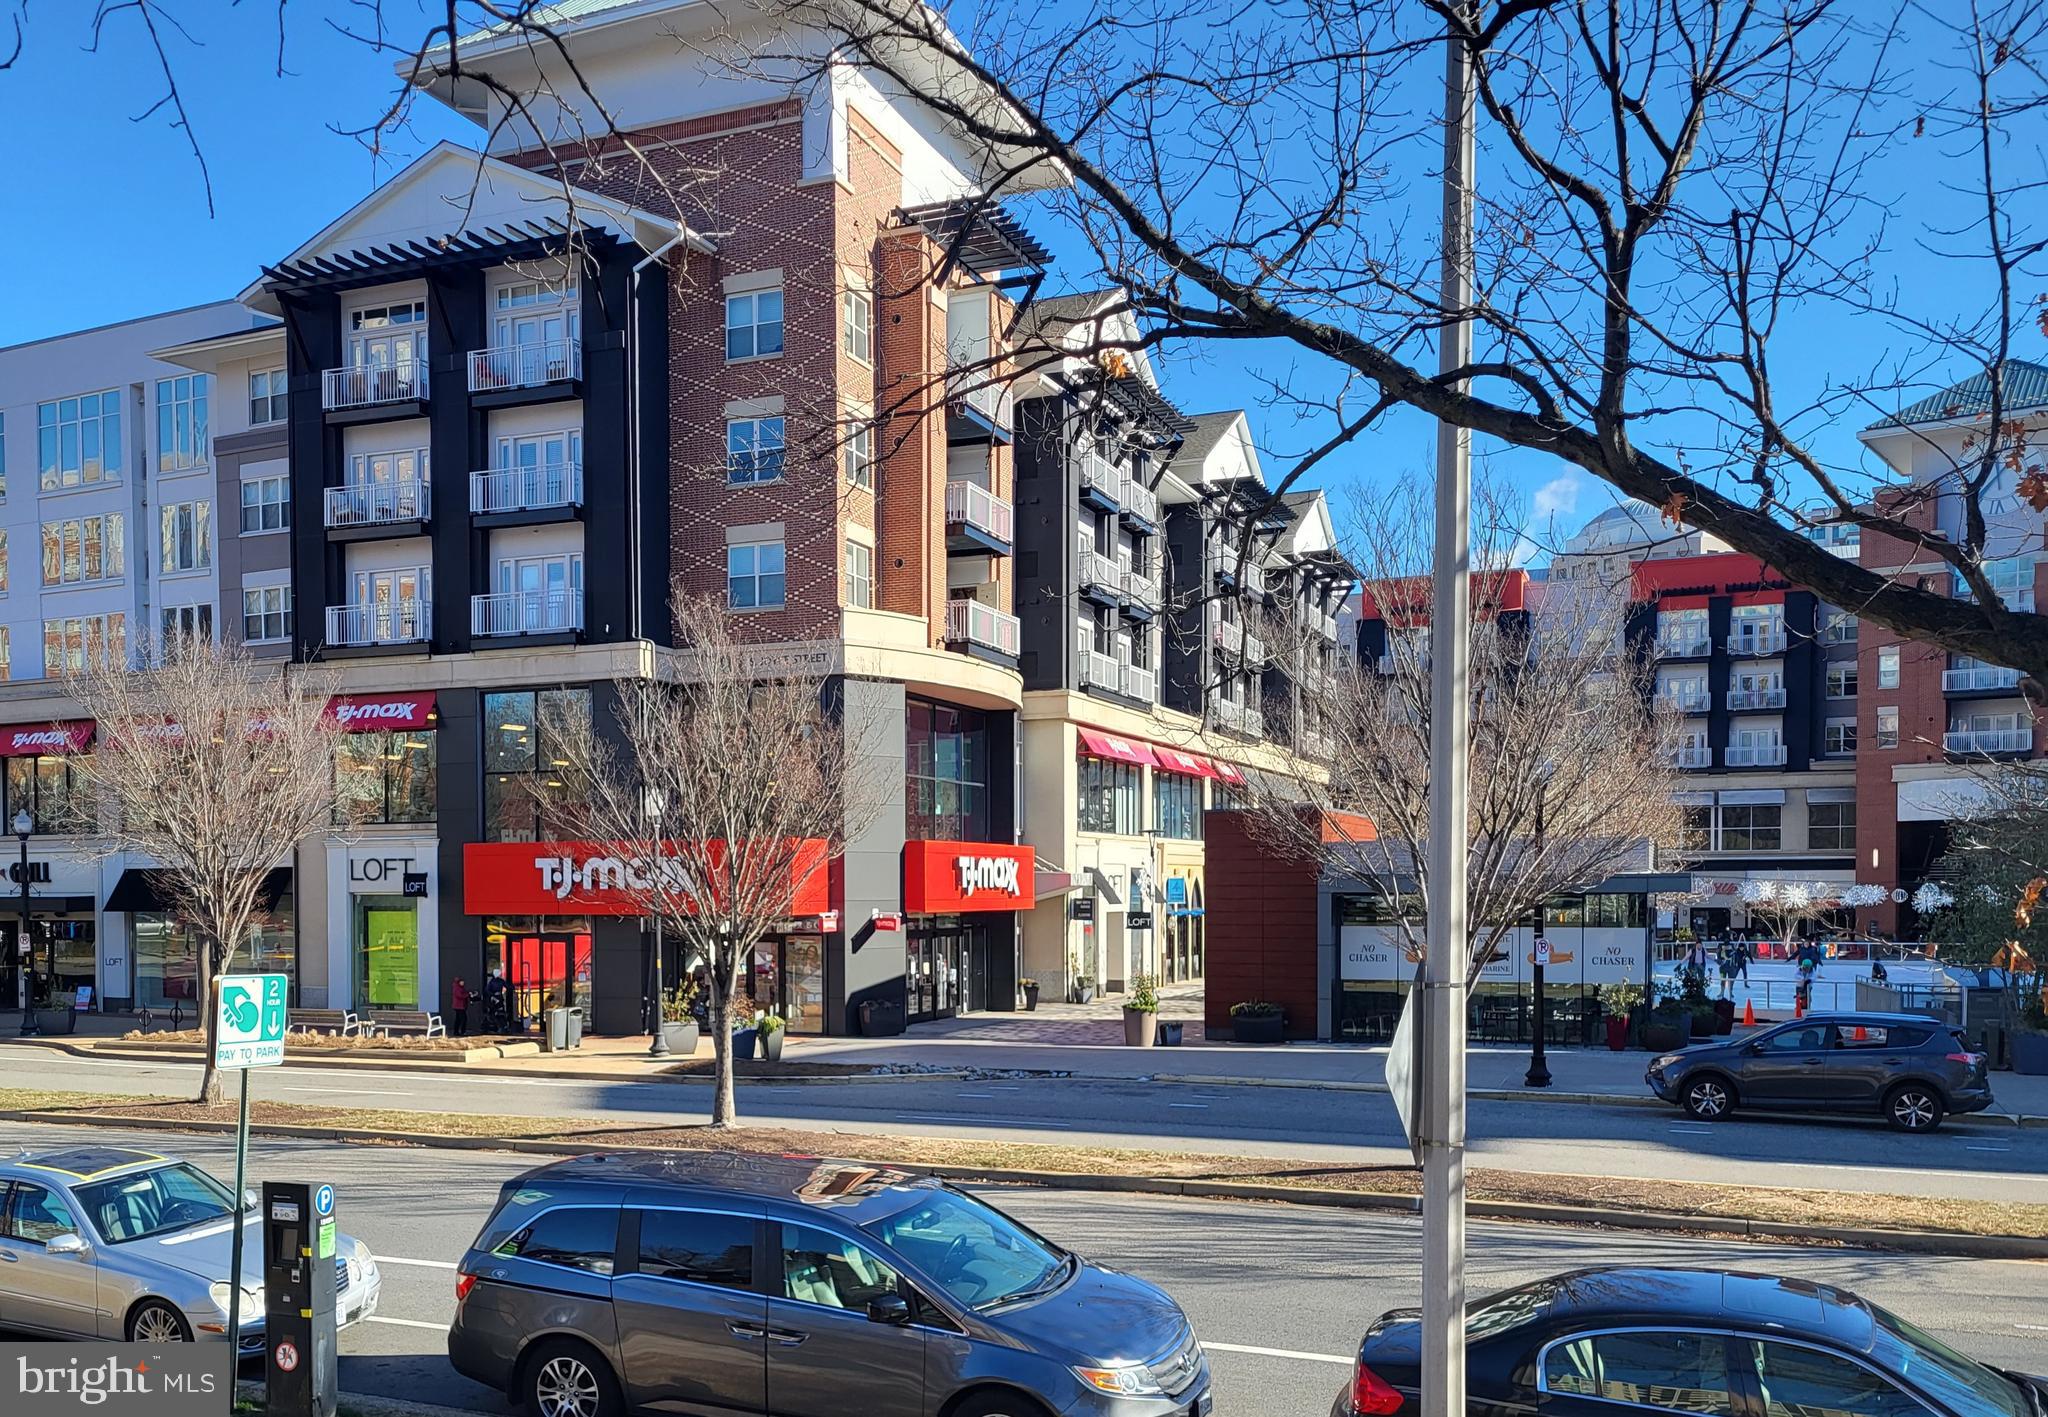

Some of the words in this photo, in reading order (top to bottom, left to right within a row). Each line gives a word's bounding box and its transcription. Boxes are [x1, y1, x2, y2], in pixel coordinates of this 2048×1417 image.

[9, 862, 52, 883] GILL
[350, 857, 415, 881] LOFT
[405, 882, 425, 892] LOFT
[1127, 917, 1151, 927] LOFT
[1361, 944, 1376, 953] NO
[1605, 946, 1621, 956] NO
[105, 957, 123, 967] LOFT
[1348, 953, 1388, 962] CHASER
[1591, 956, 1635, 966] CHASER
[269, 980, 279, 997] 2
[218, 1049, 236, 1061] PAY
[240, 1047, 253, 1060] TO
[256, 1046, 281, 1058] PARK
